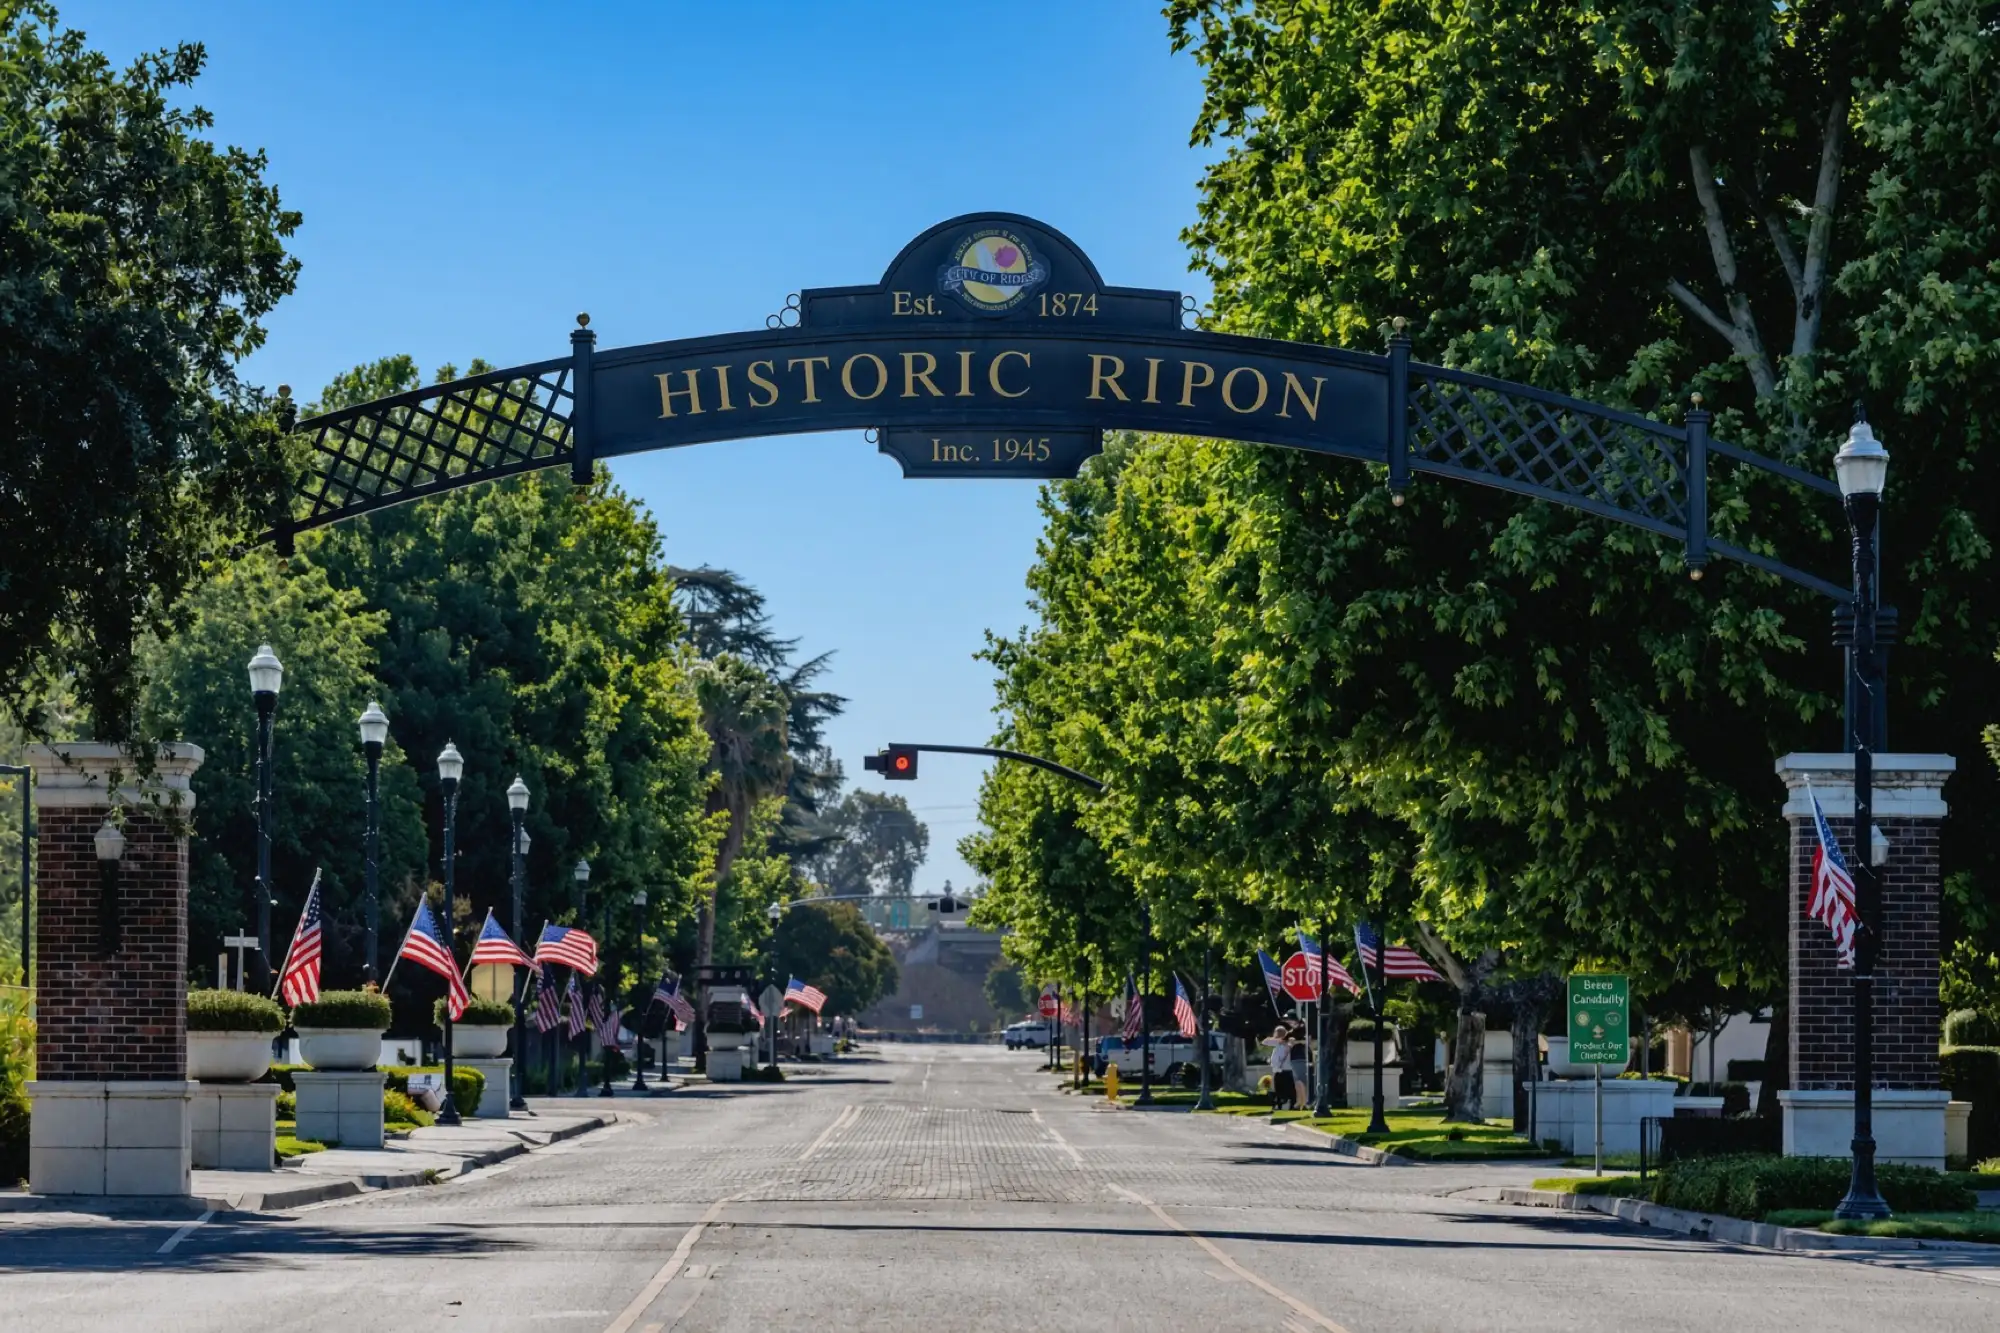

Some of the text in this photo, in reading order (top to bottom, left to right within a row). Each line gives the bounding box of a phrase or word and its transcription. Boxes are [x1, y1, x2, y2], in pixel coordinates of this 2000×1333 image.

[980, 271, 997, 284] OF
[892, 291, 943, 316] Est.
[1038, 293, 1099, 317] 1874
[654, 351, 1328, 421] HISTORIC RIPON
[931, 438, 1051, 462] Inc. 1945
